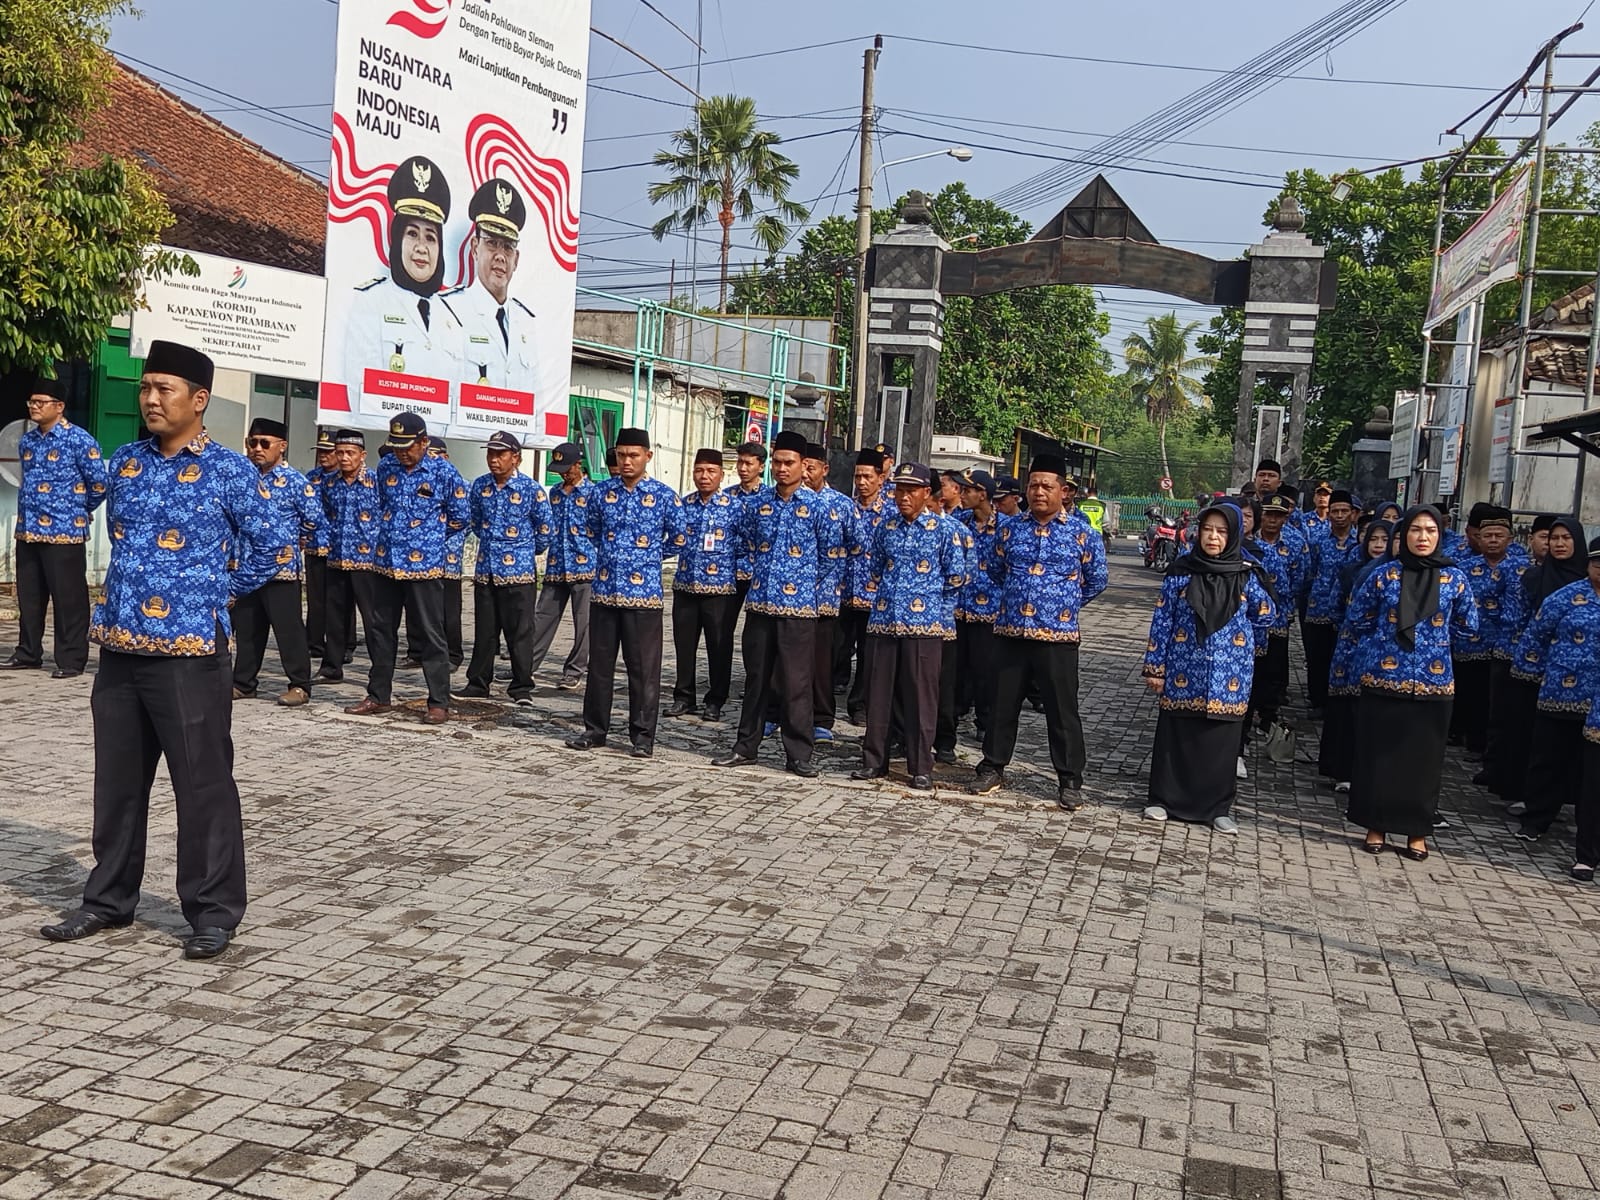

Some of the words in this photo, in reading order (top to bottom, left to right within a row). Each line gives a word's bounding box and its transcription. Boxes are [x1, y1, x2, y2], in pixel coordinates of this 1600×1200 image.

[461, 0, 490, 21] Jadilah
[490, 12, 526, 38] Pahlawan
[528, 31, 554, 51] Sleman
[459, 16, 489, 40] Dengan
[491, 31, 512, 50] Tertib
[513, 41, 534, 59] Bayar
[535, 51, 555, 69] Pajak
[557, 60, 582, 80] Daerah
[359, 59, 402, 91] BARU
[360, 37, 453, 91] NUSANTARA
[459, 47, 479, 66] Mari
[480, 56, 520, 83] Lanjutkan
[521, 76, 578, 109] Pembangunan!
[356, 109, 402, 140] MAJU
[357, 87, 441, 134] INDONESIA
[167, 303, 234, 322] KAPANEWON
[235, 314, 297, 333] PRAMBANAN
[212, 300, 257, 316] (KORMI)
[201, 336, 262, 352] SEKRETARIAT
[381, 401, 405, 412] BUPATI
[405, 404, 432, 415] SLEMAN
[465, 411, 485, 422] WAKIL
[485, 414, 505, 425] BUPATI
[506, 416, 529, 427] SLEMAN
